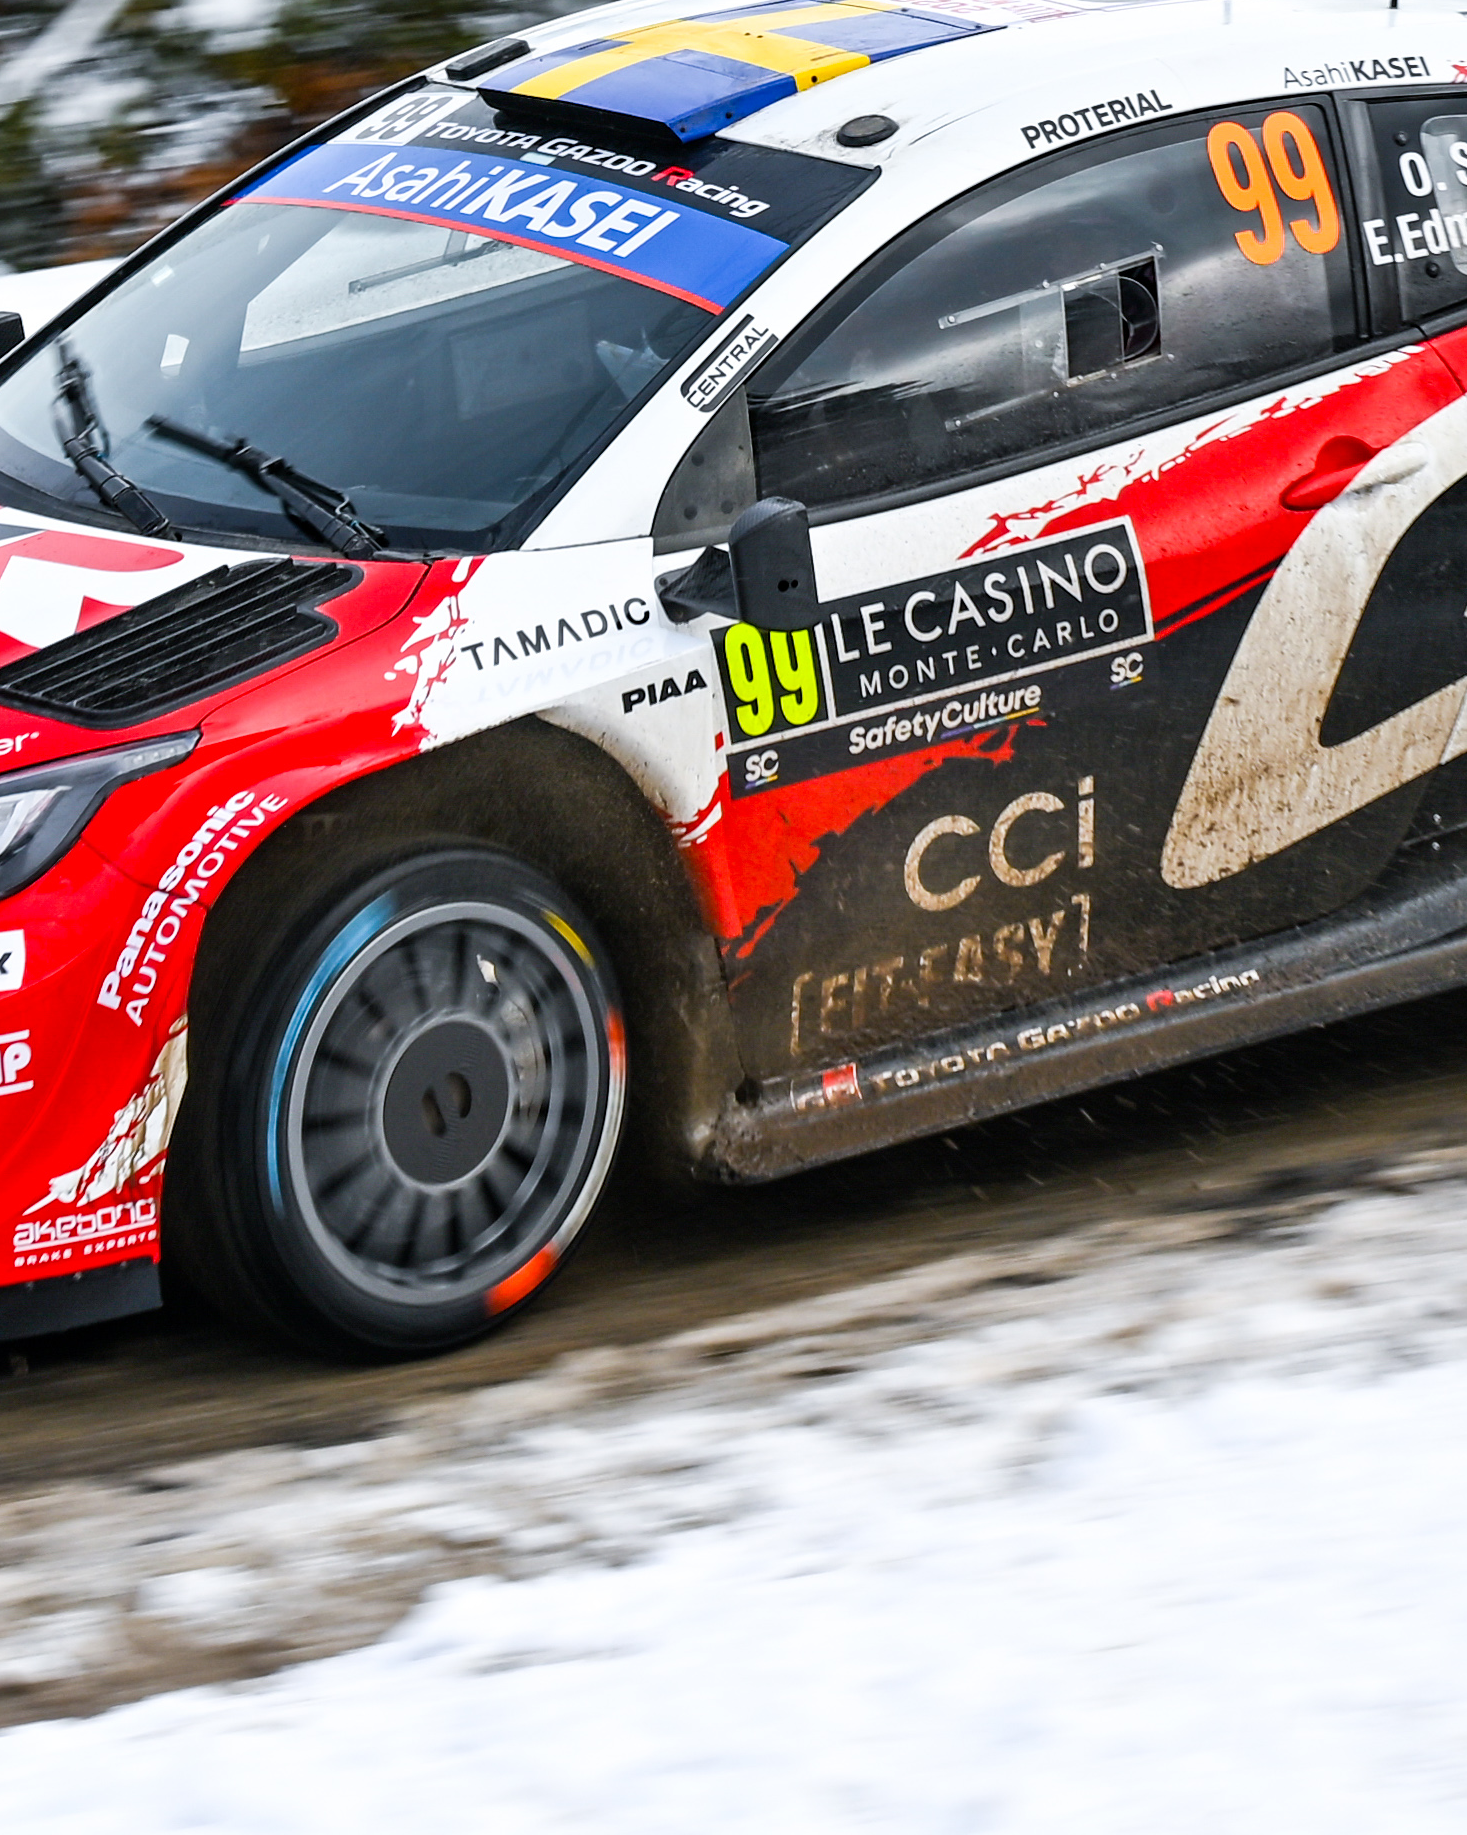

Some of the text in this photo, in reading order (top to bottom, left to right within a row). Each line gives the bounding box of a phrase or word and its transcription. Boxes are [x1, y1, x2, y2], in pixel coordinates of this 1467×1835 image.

[1284, 55, 1432, 89] AsahiKASEI
[355, 96, 453, 140] 99
[1020, 88, 1174, 150] PROTERIAL
[322, 151, 681, 258] AsahiKASEI
[425, 121, 771, 218] TOYOTA GAZOO Racing
[1206, 110, 1341, 265] 99
[1398, 150, 1448, 198] O.
[686, 327, 770, 409] CENTRAL
[459, 596, 651, 672] TAMADIC
[830, 542, 1128, 664] LE CASINO
[621, 667, 709, 715] PIAA
[724, 621, 820, 737] 99
[1110, 651, 1145, 683] SC
[848, 684, 1043, 755] SafetyCulture
[744, 747, 780, 783] SC
[96, 789, 257, 1010] Panasonic
[124, 792, 290, 1027] AUTOMOTIVE
[12, 1197, 157, 1247] akebono
[13, 1229, 158, 1268] BRAKE EXPERTS
